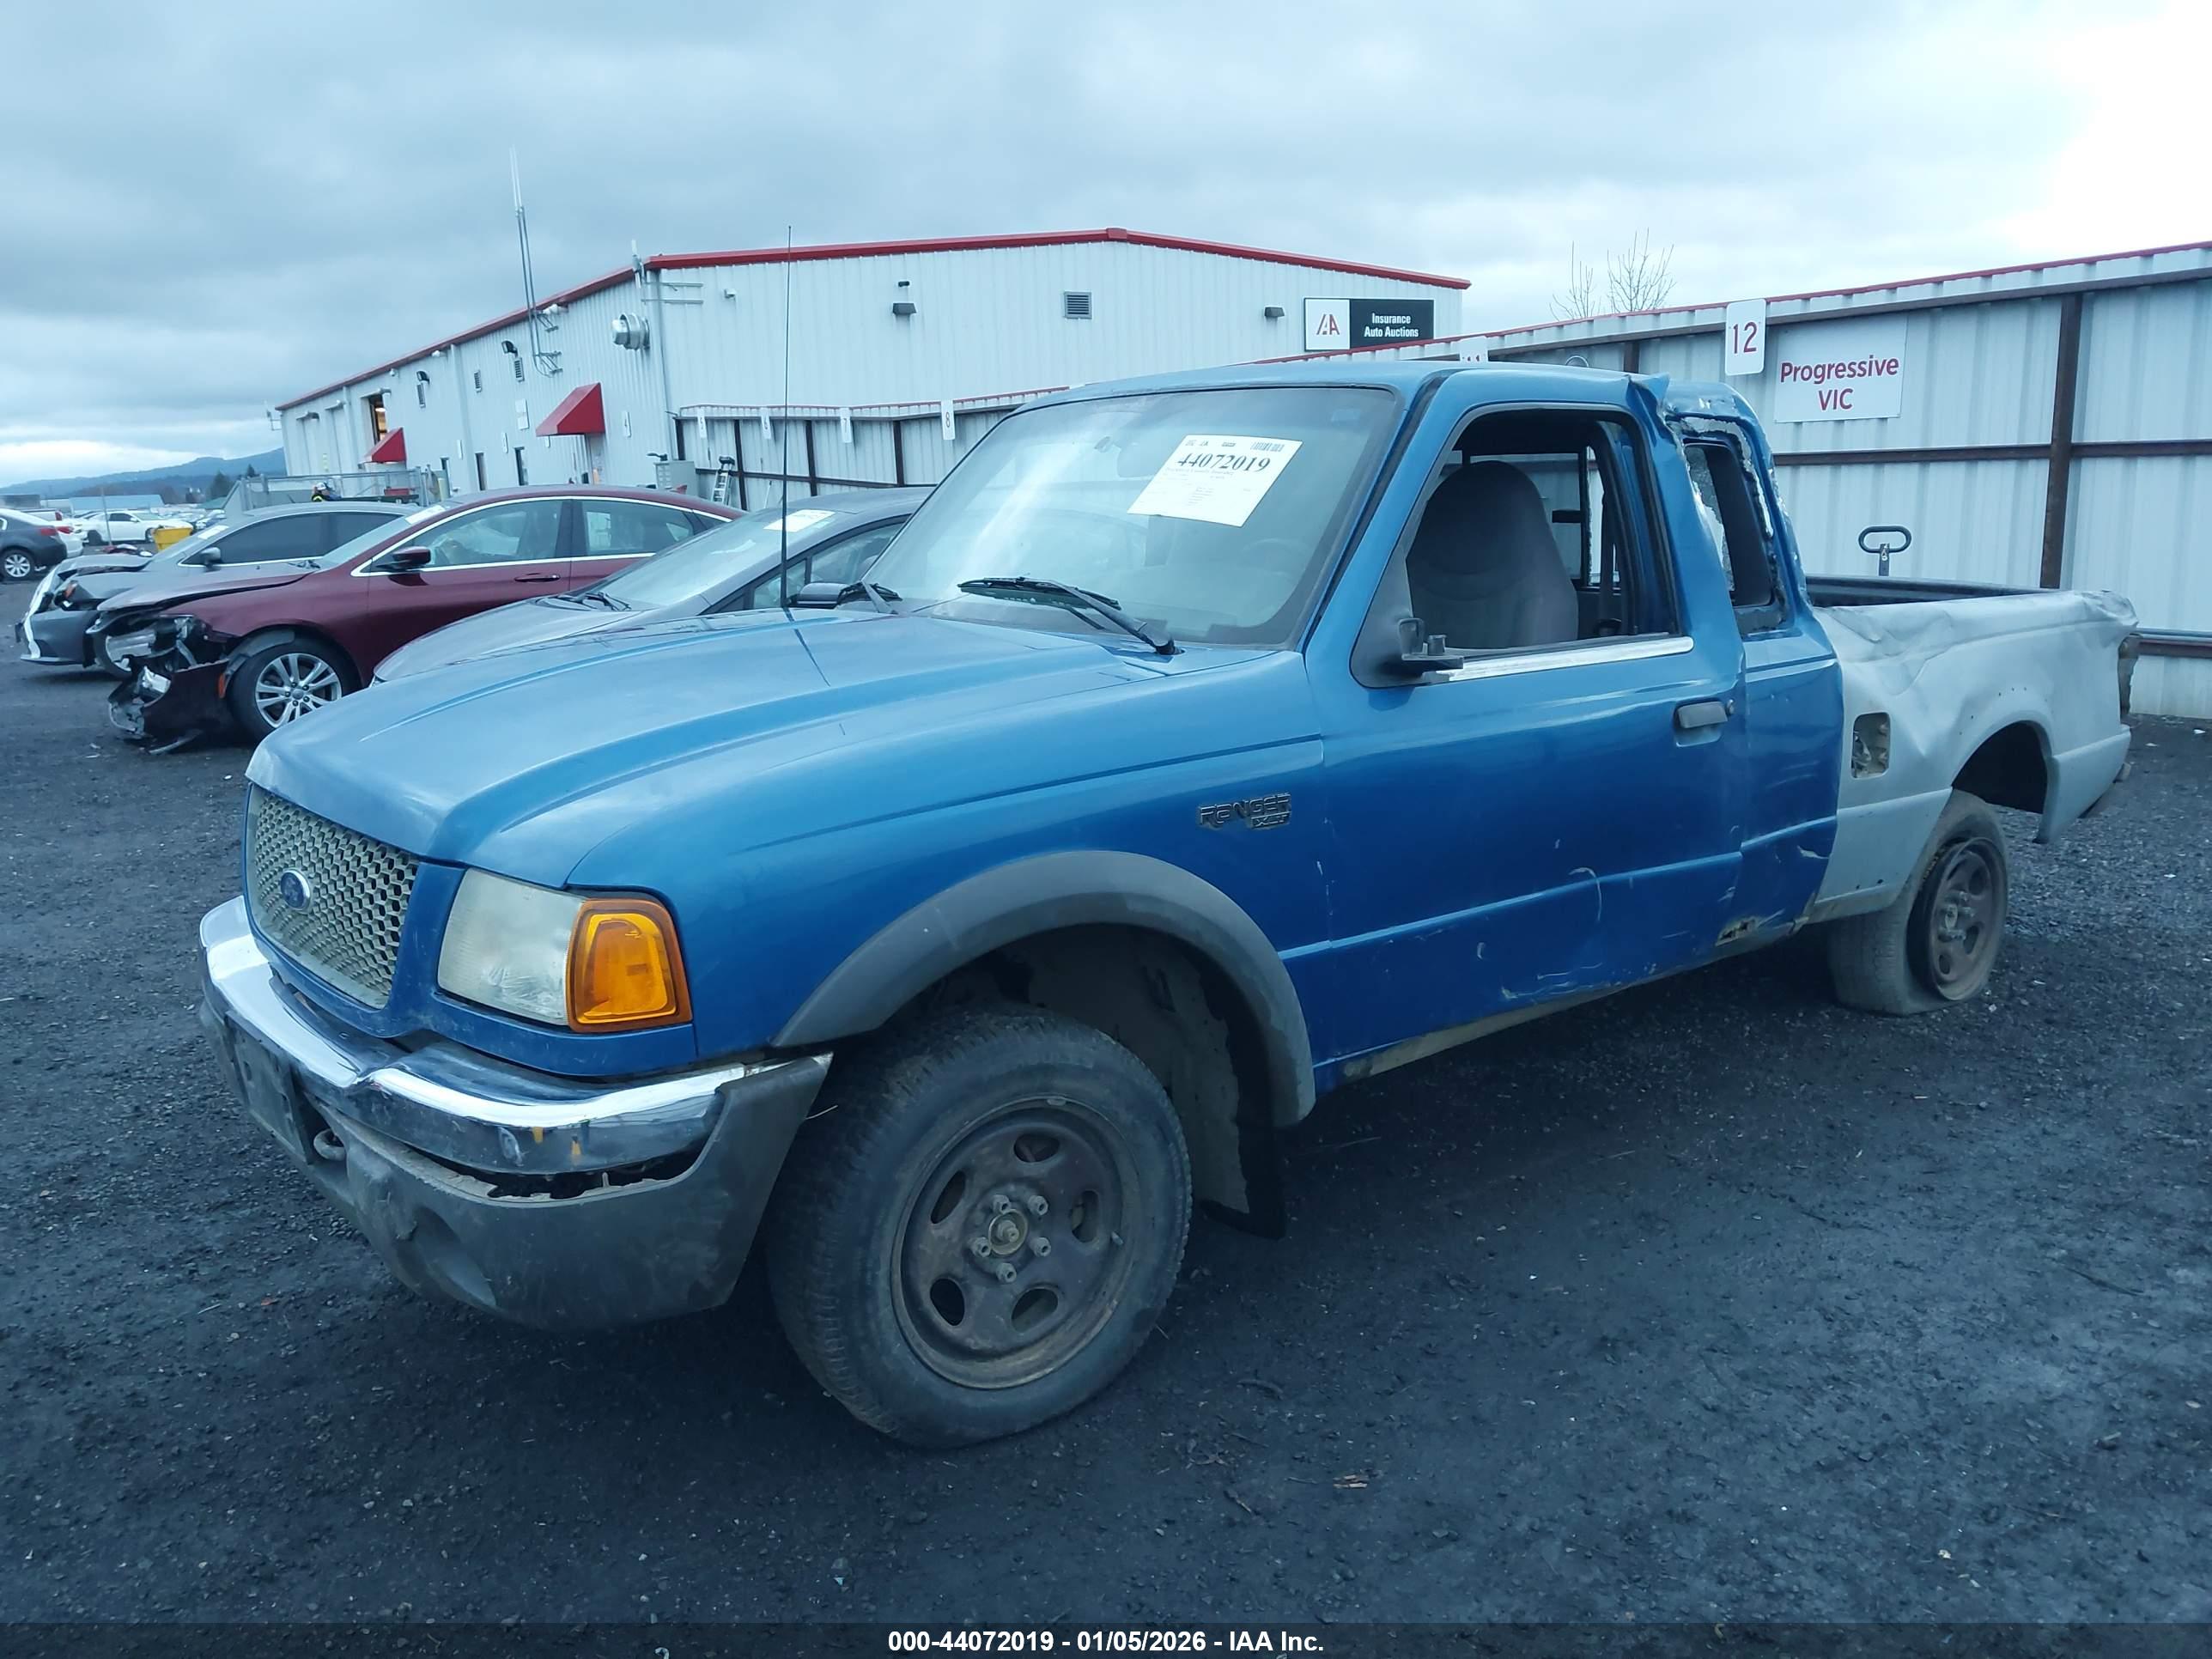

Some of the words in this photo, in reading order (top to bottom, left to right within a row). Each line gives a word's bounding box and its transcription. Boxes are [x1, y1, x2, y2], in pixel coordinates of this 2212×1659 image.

[1371, 313, 1412, 325] Insurance
[1364, 325, 1383, 338] Auto
[1384, 325, 1419, 337] Auctions
[1732, 320, 1758, 355] 12
[1780, 355, 1899, 385] Progressive
[1818, 388, 1853, 411] VIC
[1176, 453, 1271, 472] 44072019
